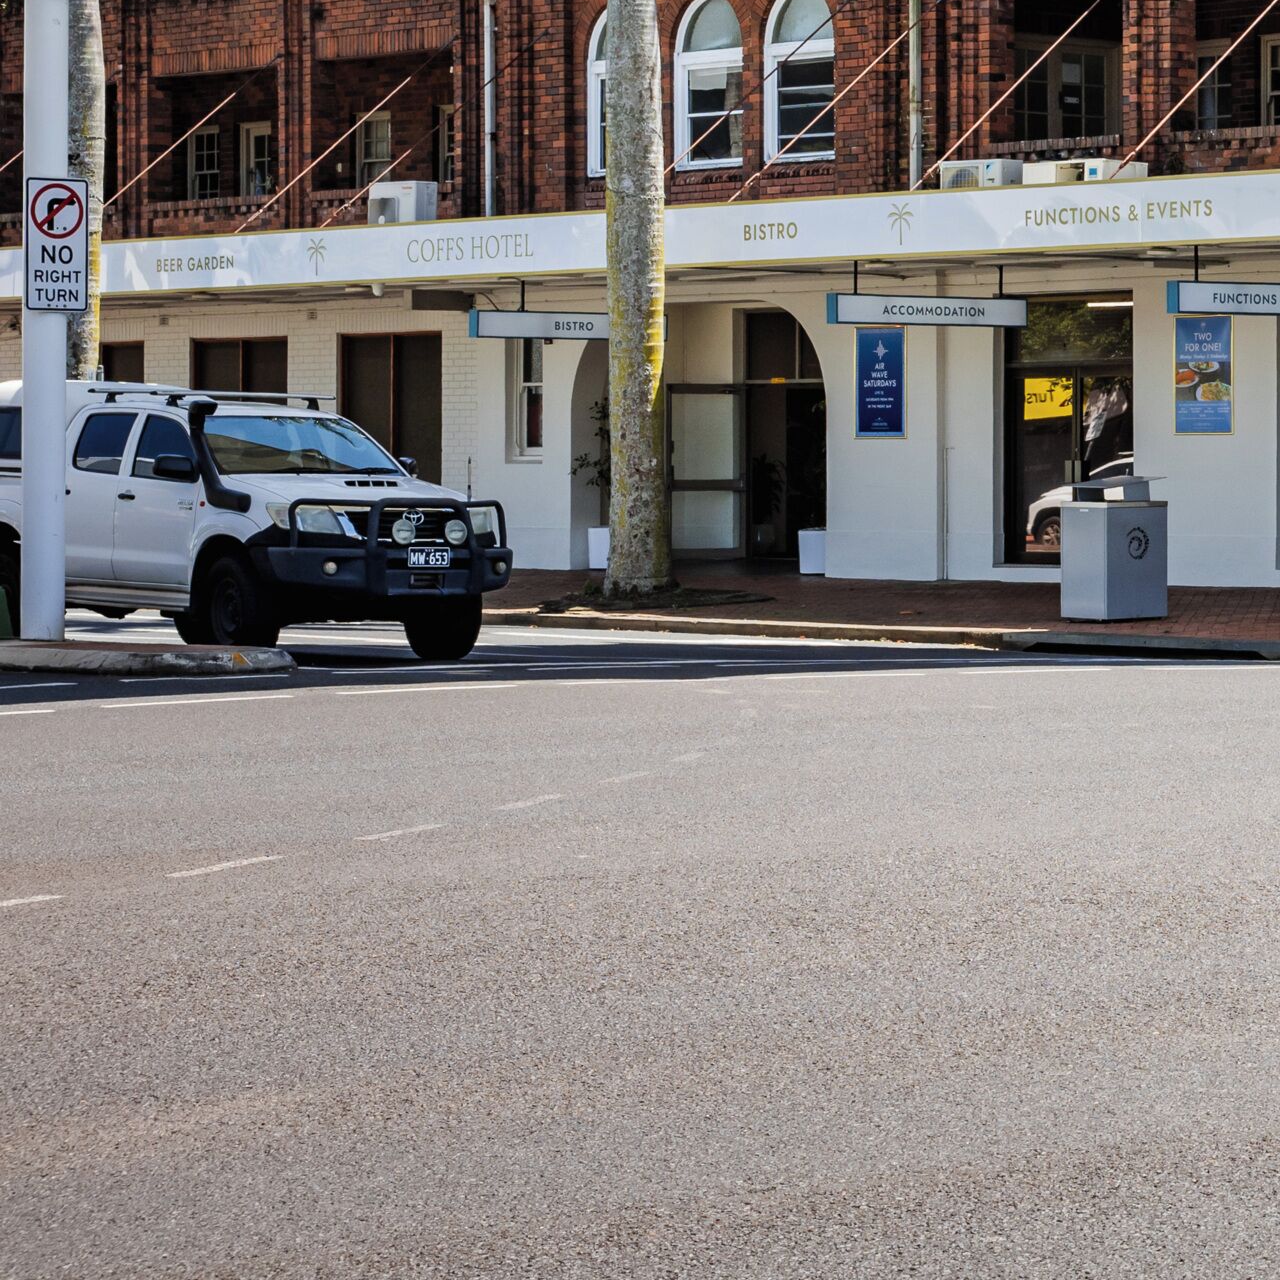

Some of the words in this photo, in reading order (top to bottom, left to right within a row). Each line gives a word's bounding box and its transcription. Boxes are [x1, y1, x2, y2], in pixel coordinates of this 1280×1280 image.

[1025, 205, 1121, 227] FUNCTIONS
[1127, 204, 1139, 221] &
[1146, 199, 1213, 220] EVENTS
[743, 221, 798, 241] BISTRO
[41, 244, 74, 265] NO
[406, 236, 464, 263] COFFS
[471, 233, 534, 260] HOTEL
[156, 257, 183, 272] BEER
[187, 255, 234, 271] GARDEN
[34, 269, 81, 283] RIGHT
[35, 288, 79, 302] TURN
[1213, 292, 1277, 305] FUNCTIONS
[882, 305, 985, 317] ACCOMMODATION
[554, 321, 594, 331] BISTRO
[1193, 332, 1212, 341] TWO
[1184, 343, 1200, 352] FOR
[1201, 342, 1222, 352] ONE!
[874, 362, 885, 370] AIR
[871, 371, 888, 379] WAVE
[863, 379, 897, 388] SATURDAYS
